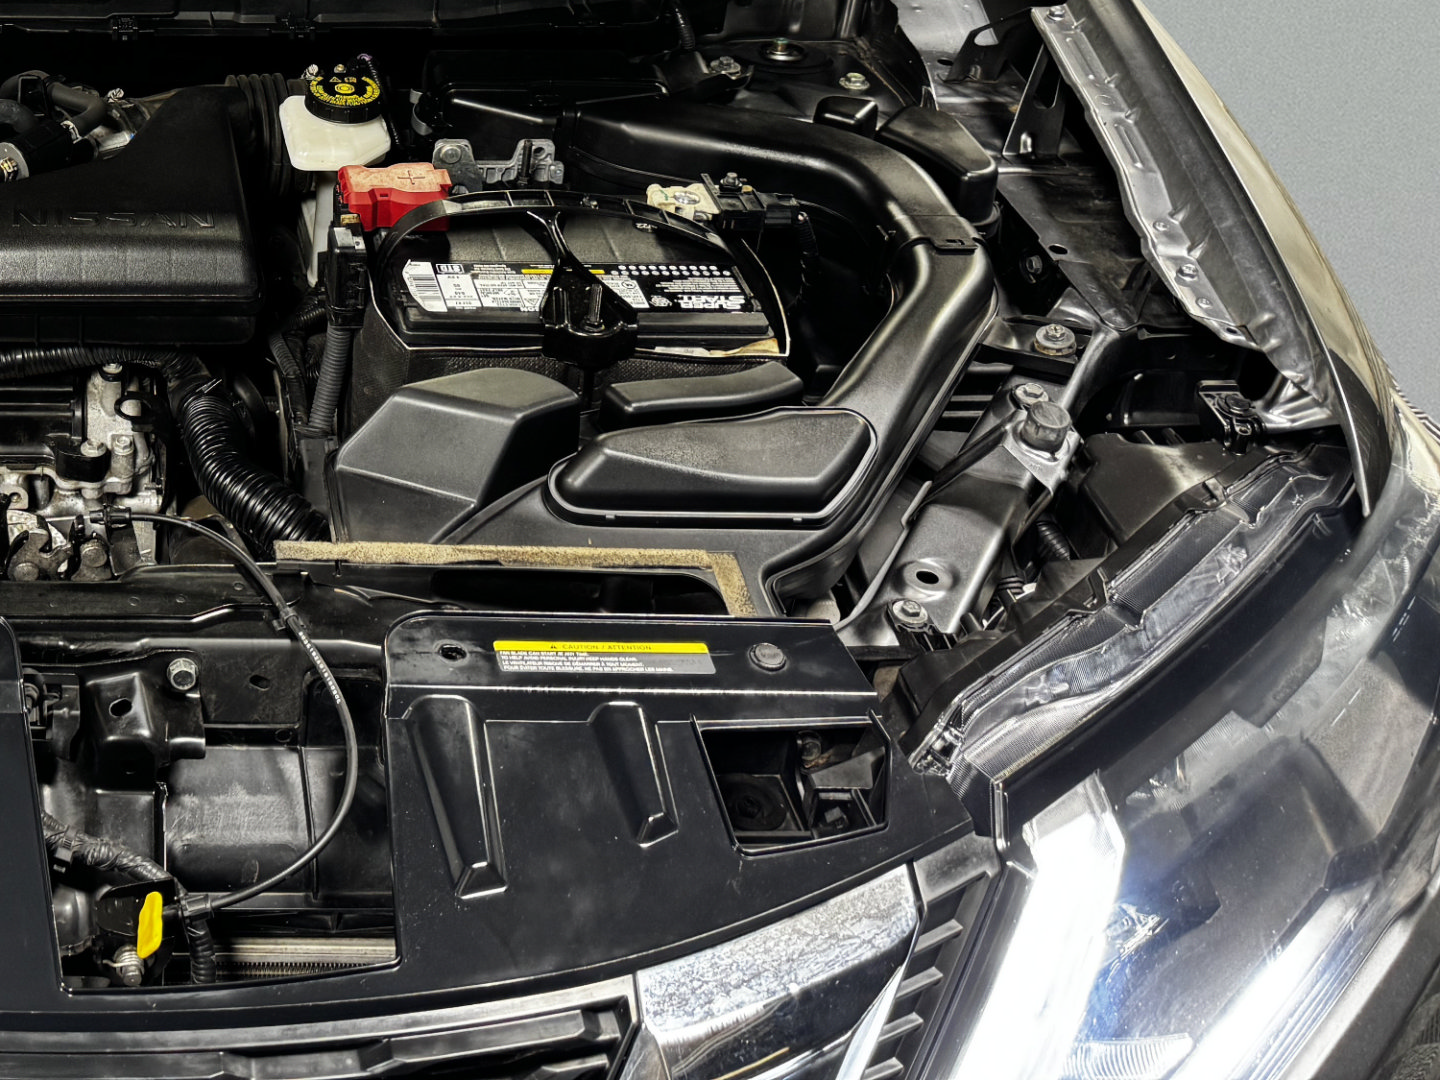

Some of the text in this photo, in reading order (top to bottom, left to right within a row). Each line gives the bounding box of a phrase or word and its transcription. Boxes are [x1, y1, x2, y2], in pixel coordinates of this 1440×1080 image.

[11, 208, 216, 228] NISSAN
[677, 294, 746, 304] START
[680, 300, 742, 309] SUPER
